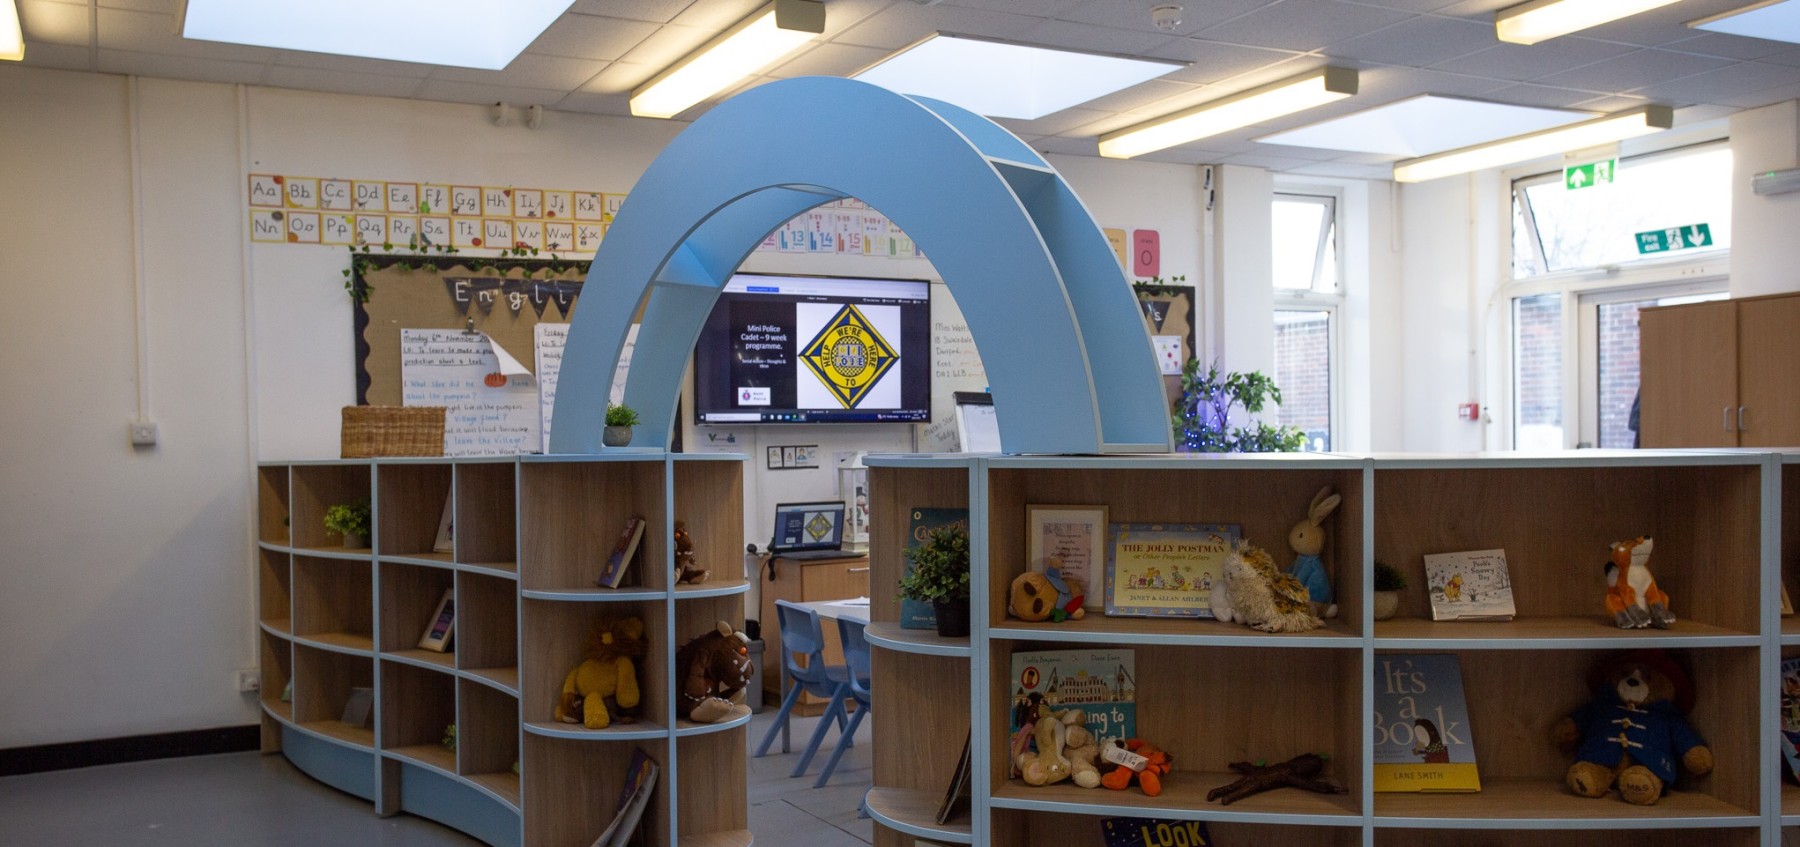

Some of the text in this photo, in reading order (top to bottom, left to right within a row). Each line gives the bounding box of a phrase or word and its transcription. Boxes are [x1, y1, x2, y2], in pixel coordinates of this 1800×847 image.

[253, 181, 276, 196] Aa
[290, 183, 311, 199] Bb
[324, 182, 345, 198] Cc
[357, 184, 379, 200] Dd
[391, 187, 410, 203] Ee
[425, 188, 442, 207] Ff
[454, 192, 476, 211] Gg
[486, 194, 507, 208] Hh
[520, 194, 535, 209] Ii
[550, 194, 565, 213] Jj
[579, 198, 596, 212] Kk
[254, 217, 599, 240] Nn Oo Pp Qq Rr Ss Tt Uu Vv Ww Xx
[791, 231, 804, 243] 13
[819, 233, 833, 245] 14
[848, 233, 861, 245] 15
[873, 235, 885, 246] 16
[899, 238, 911, 249] 17
[1641, 233, 1658, 243] Fire
[1645, 242, 1660, 251] exit
[455, 281, 567, 310] Engli
[404, 334, 429, 346] Monday
[740, 333, 759, 341] Cadet
[770, 333, 787, 341] week
[745, 342, 783, 350] programme.
[822, 327, 877, 386] WE'RE HERE TO HELP
[1122, 544, 1225, 553] THE JOLLY POSTMAN
[1383, 660, 1426, 694] It's
[1111, 707, 1124, 722] to
[1398, 696, 1421, 719] a
[1394, 771, 1444, 780] LANE SMITH
[1141, 821, 1207, 847] LOOK
